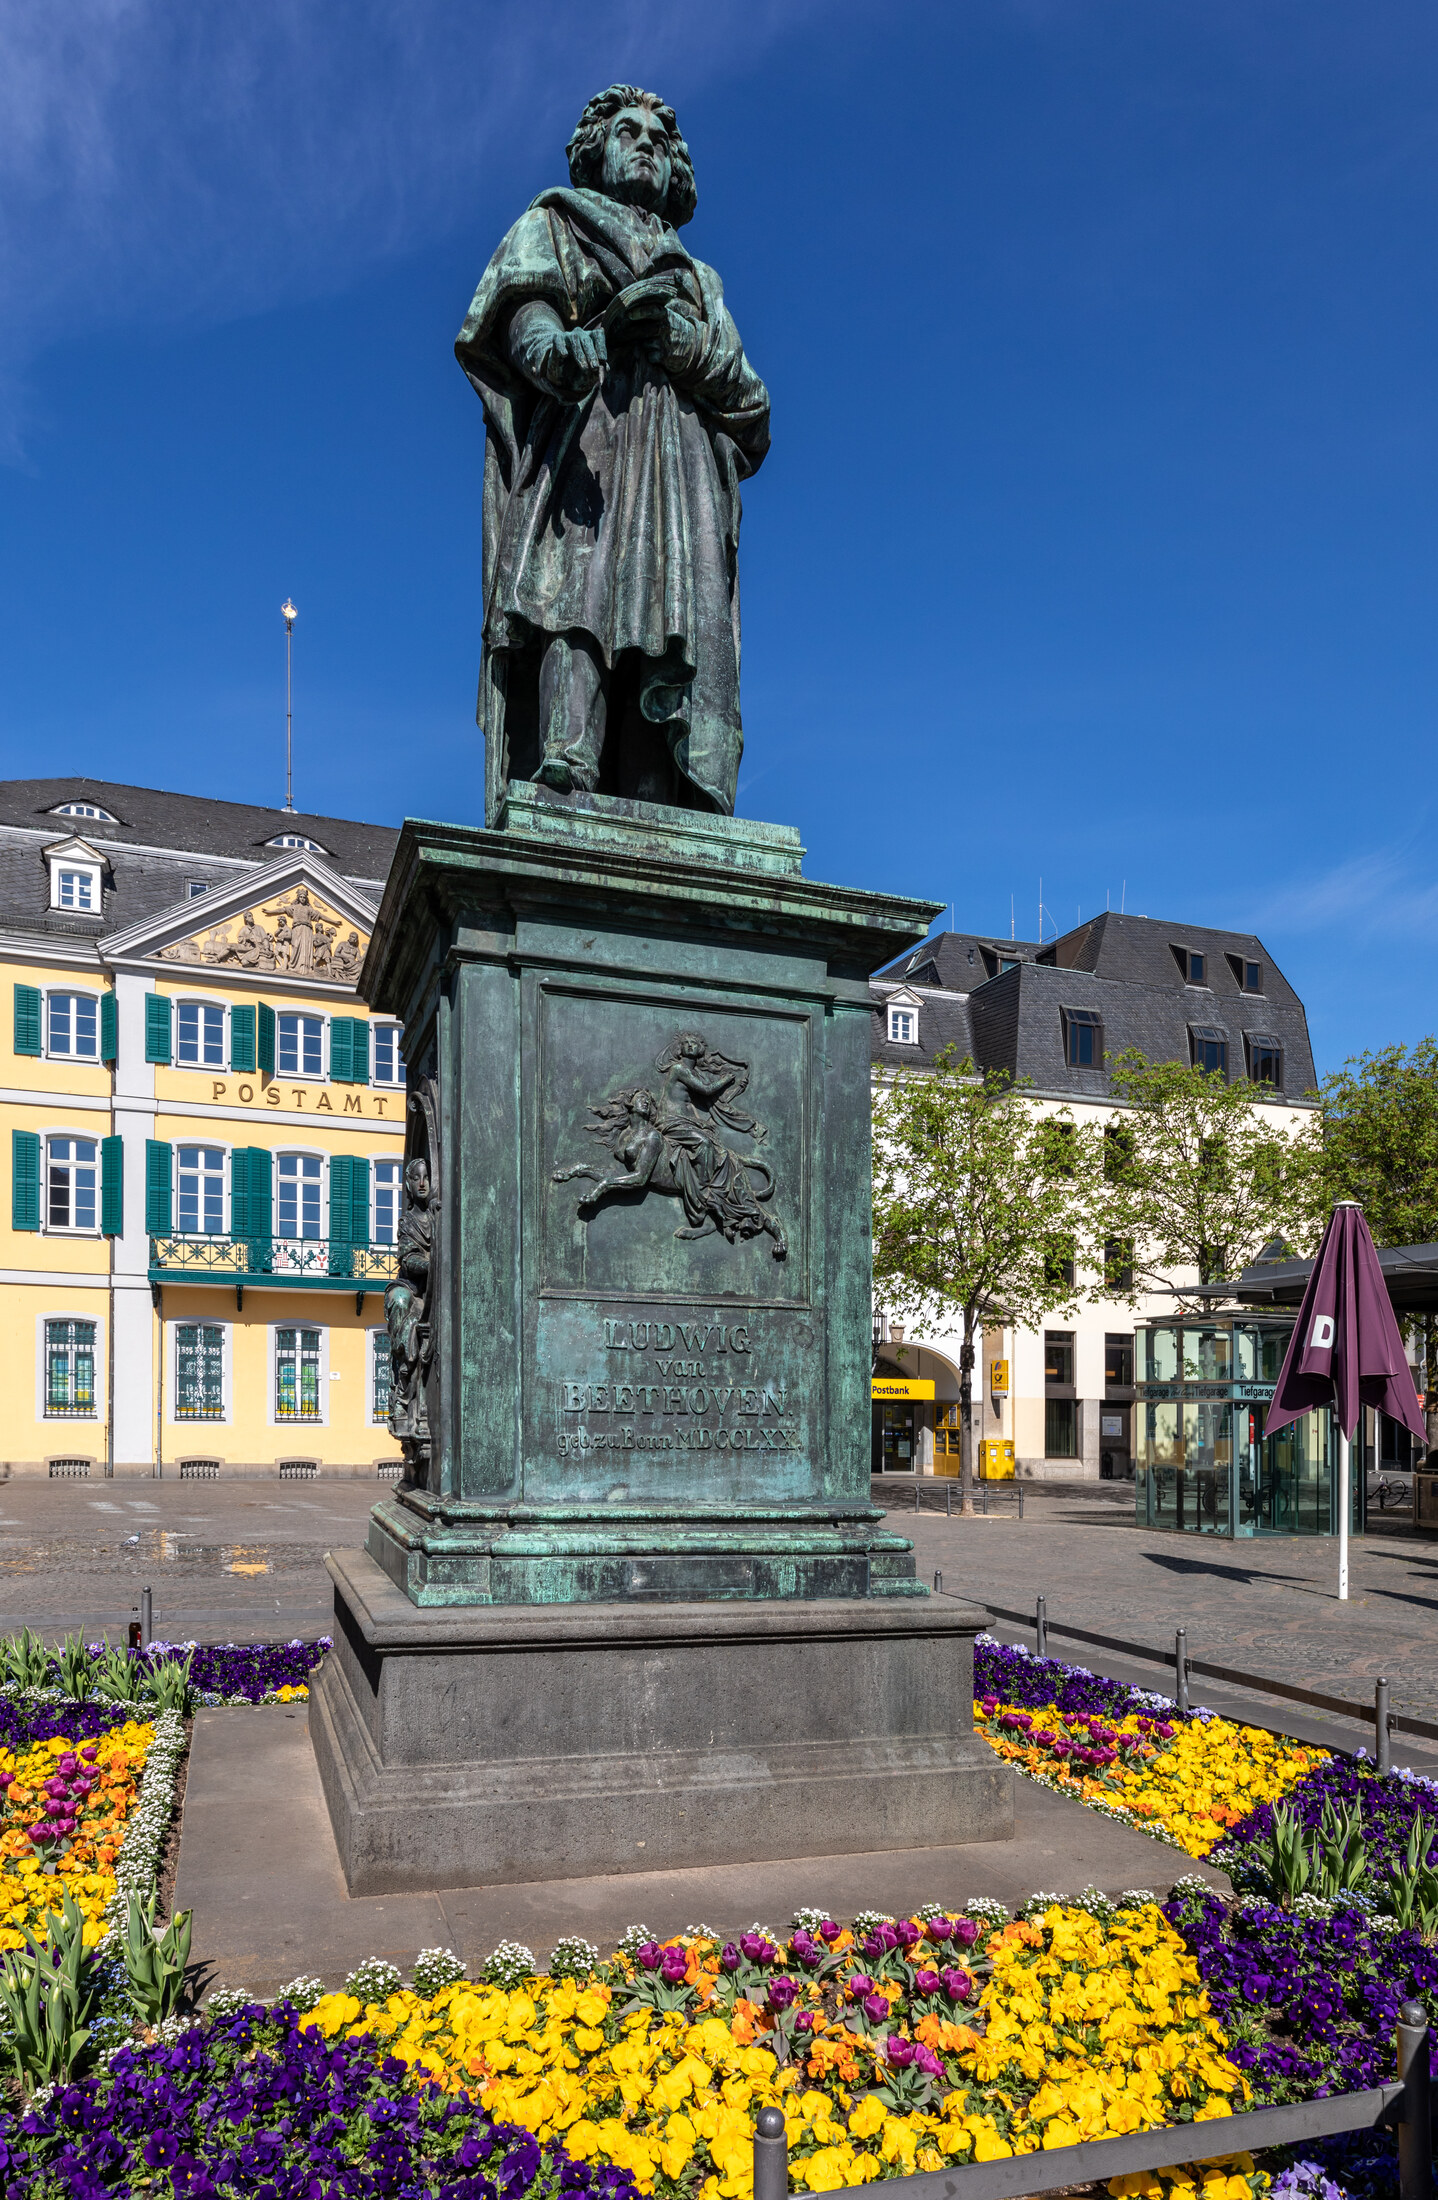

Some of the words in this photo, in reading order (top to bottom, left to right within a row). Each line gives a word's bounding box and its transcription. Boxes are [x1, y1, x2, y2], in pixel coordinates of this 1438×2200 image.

[212, 1081, 388, 1115] POSTAMT
[603, 1318, 752, 1354] LUDWIG
[656, 1358, 706, 1378] van
[563, 1381, 795, 1418] BEETHOVEN.
[872, 1385, 910, 1395] Postbank
[1139, 1386, 1169, 1399] Tiefgarage
[1194, 1385, 1229, 1399] Tiefgarage
[620, 1426, 674, 1450] Bonn
[674, 1428, 803, 1451] MDCCLXX.
